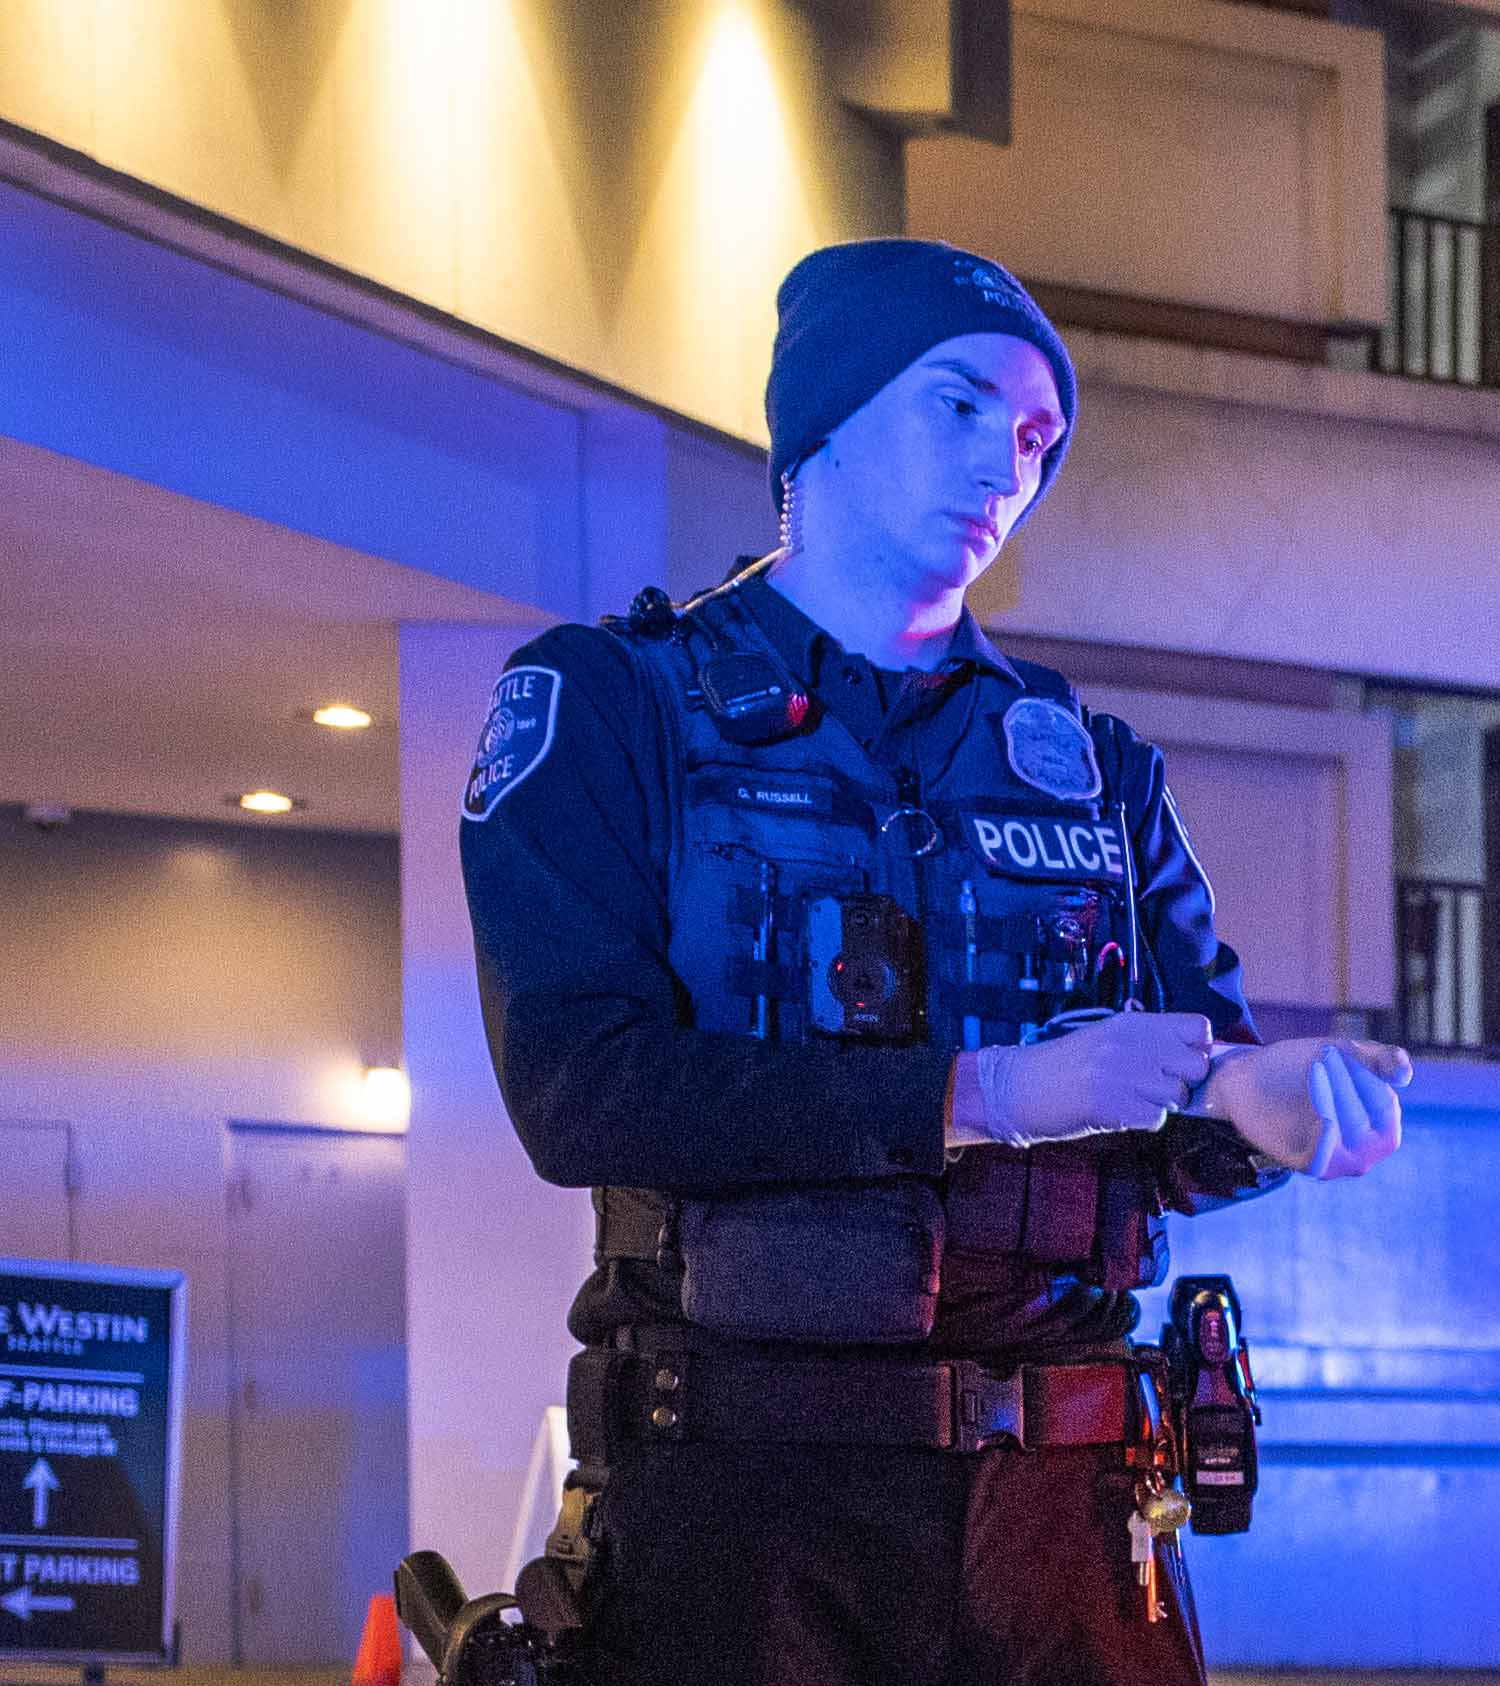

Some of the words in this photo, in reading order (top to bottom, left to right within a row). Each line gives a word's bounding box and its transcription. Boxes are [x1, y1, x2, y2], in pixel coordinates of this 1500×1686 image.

[756, 790, 813, 804] RUSSELL
[973, 818, 1123, 875] POLICE
[24, 1553, 140, 1586] PARKING
